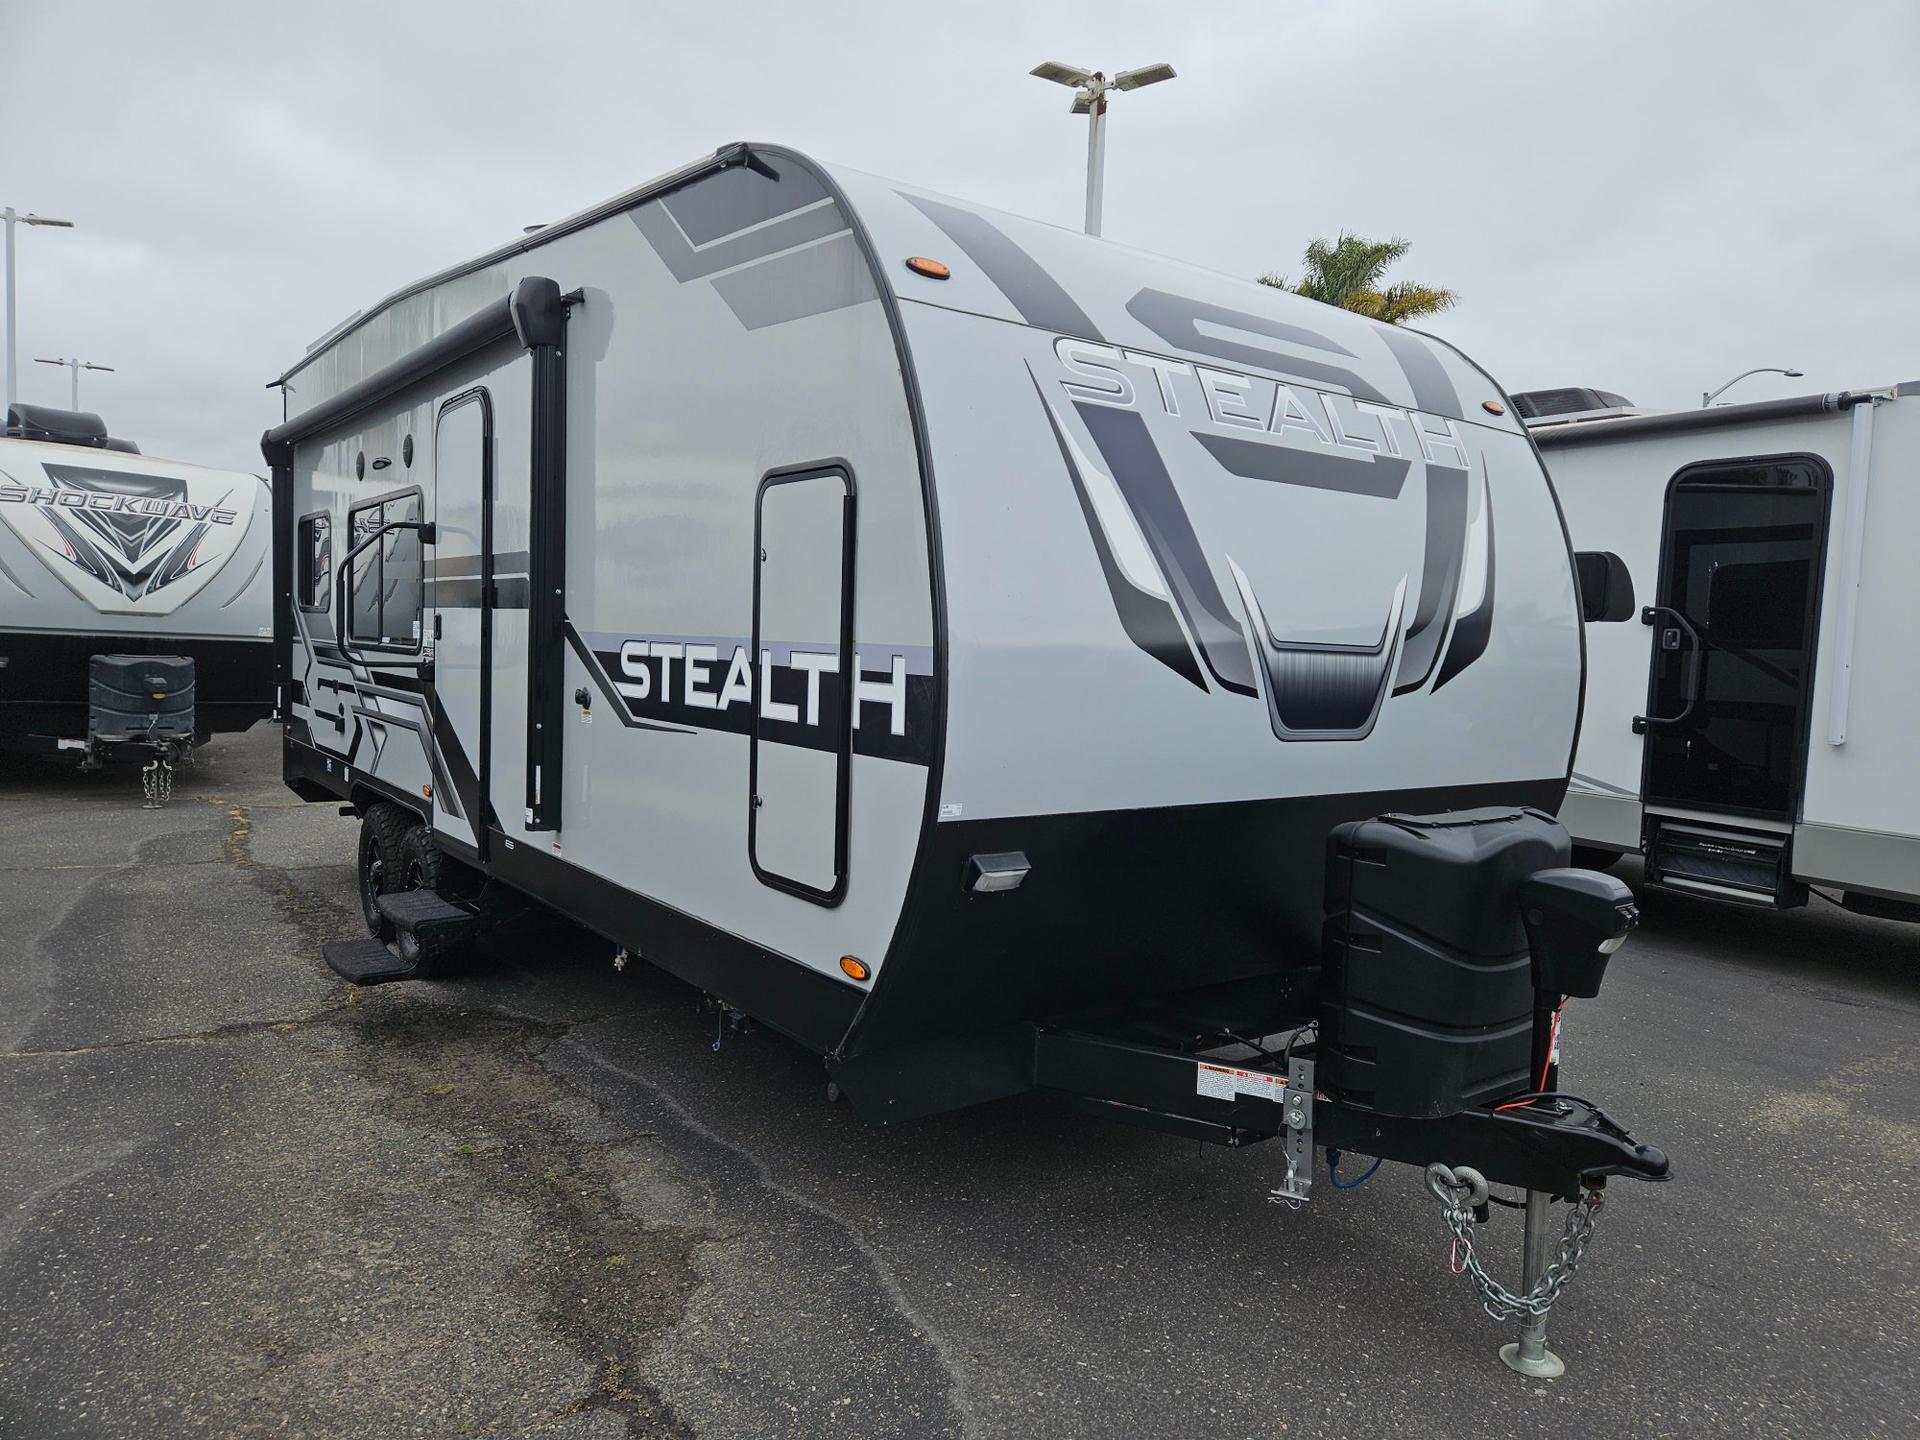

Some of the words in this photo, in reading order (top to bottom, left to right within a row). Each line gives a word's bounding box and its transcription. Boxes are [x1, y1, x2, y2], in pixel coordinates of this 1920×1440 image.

[1054, 336, 1471, 469] STEALTH
[0, 484, 238, 526] SHOCKWAVE
[615, 639, 906, 737] STEALTH
